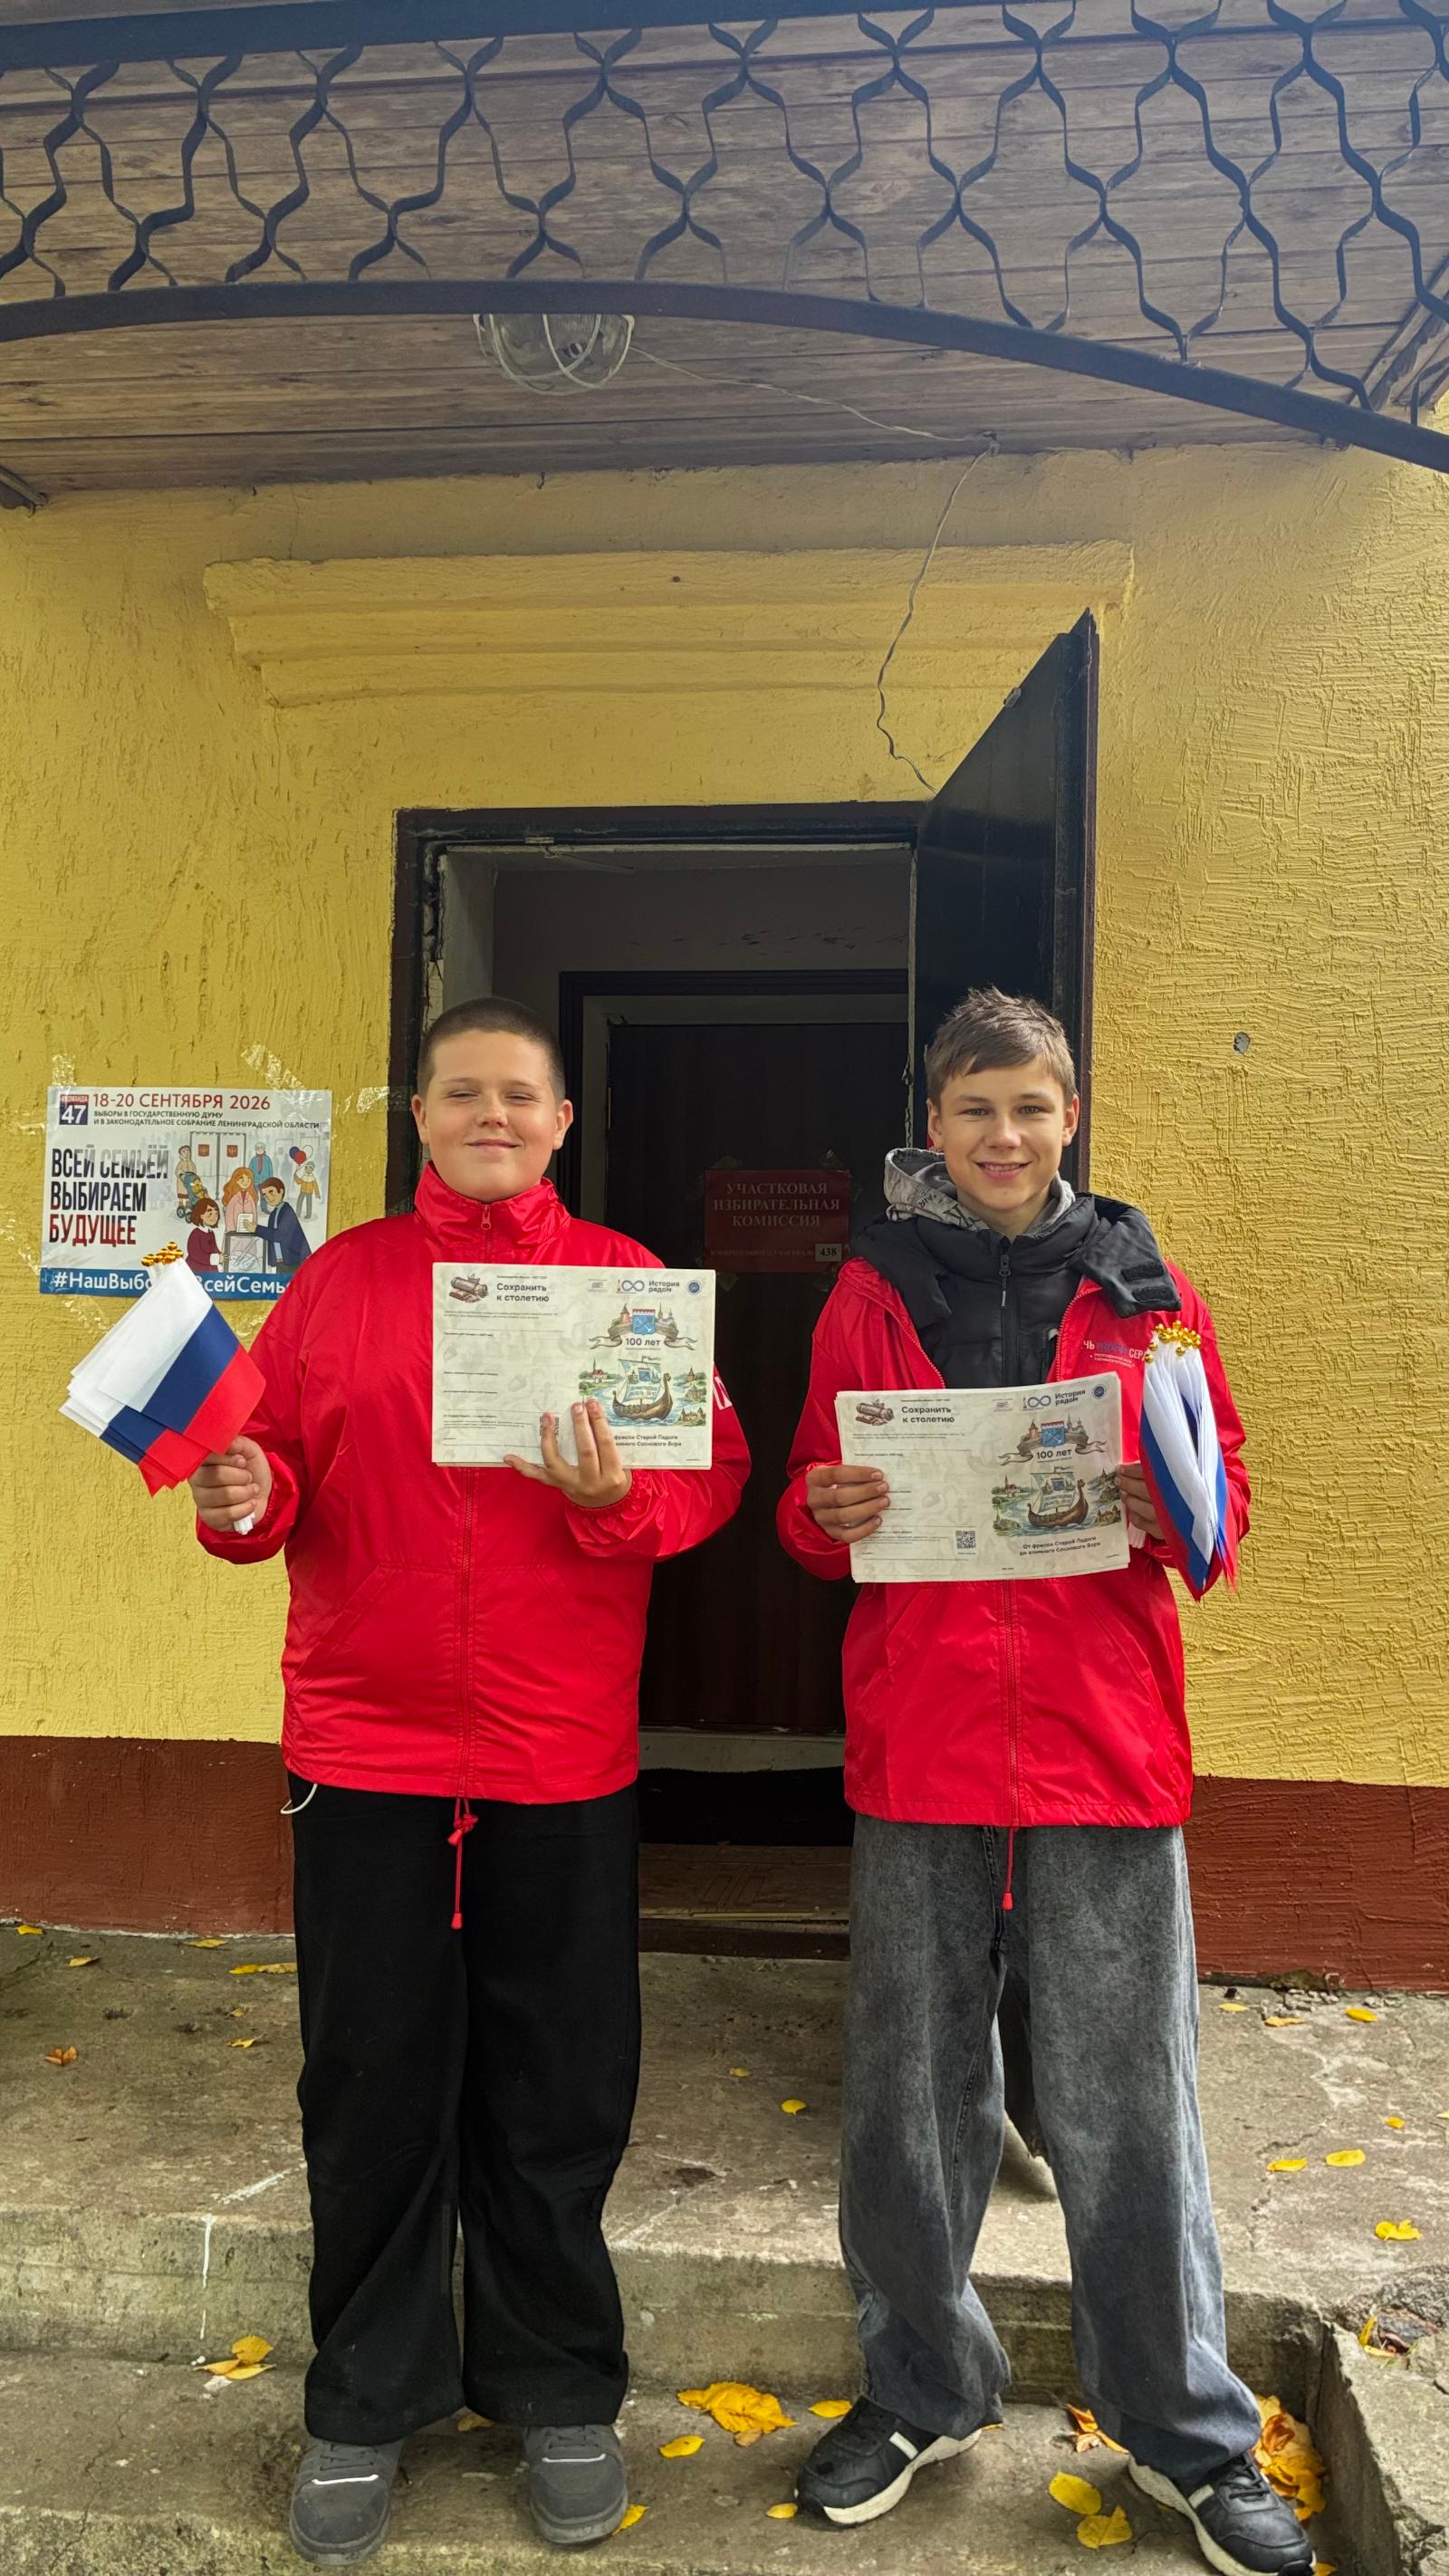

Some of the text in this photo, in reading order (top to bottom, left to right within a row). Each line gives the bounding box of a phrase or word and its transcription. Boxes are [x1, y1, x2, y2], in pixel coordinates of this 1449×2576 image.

[93, 1093, 271, 1110] 18-20 СЕНТЯБРЯ 2026
[62, 1104, 87, 1124] 47
[130, 1110, 200, 1119] ГОСУДАРСТВЕННУЮ
[217, 1120, 283, 1129] ЛЕНИНГРАДСКОЙ
[52, 1144, 169, 1179] ВСЕЙ СЕМЬЁЙ
[726, 1182, 828, 1195] УЧАСТКОВАЯ
[50, 1180, 147, 1212] ВЫБИРАЕМ
[714, 1199, 840, 1211] ИЗБИРАТЕЛЬНАЯ
[732, 1216, 820, 1227] КОМИССИЯ
[49, 1214, 137, 1247] БУДУЩЕЕ
[820, 1247, 837, 1257] 438
[54, 1271, 290, 1294] #НашВыбо сейСемь
[496, 1283, 547, 1293] Сохранить
[648, 1280, 680, 1288] История
[504, 1294, 550, 1302] столетию
[626, 1337, 661, 1347] 100 лет
[1054, 1389, 1086, 1399] История
[901, 1406, 952, 1415] Сохранить
[1036, 1448, 1072, 1459] 100 лет
